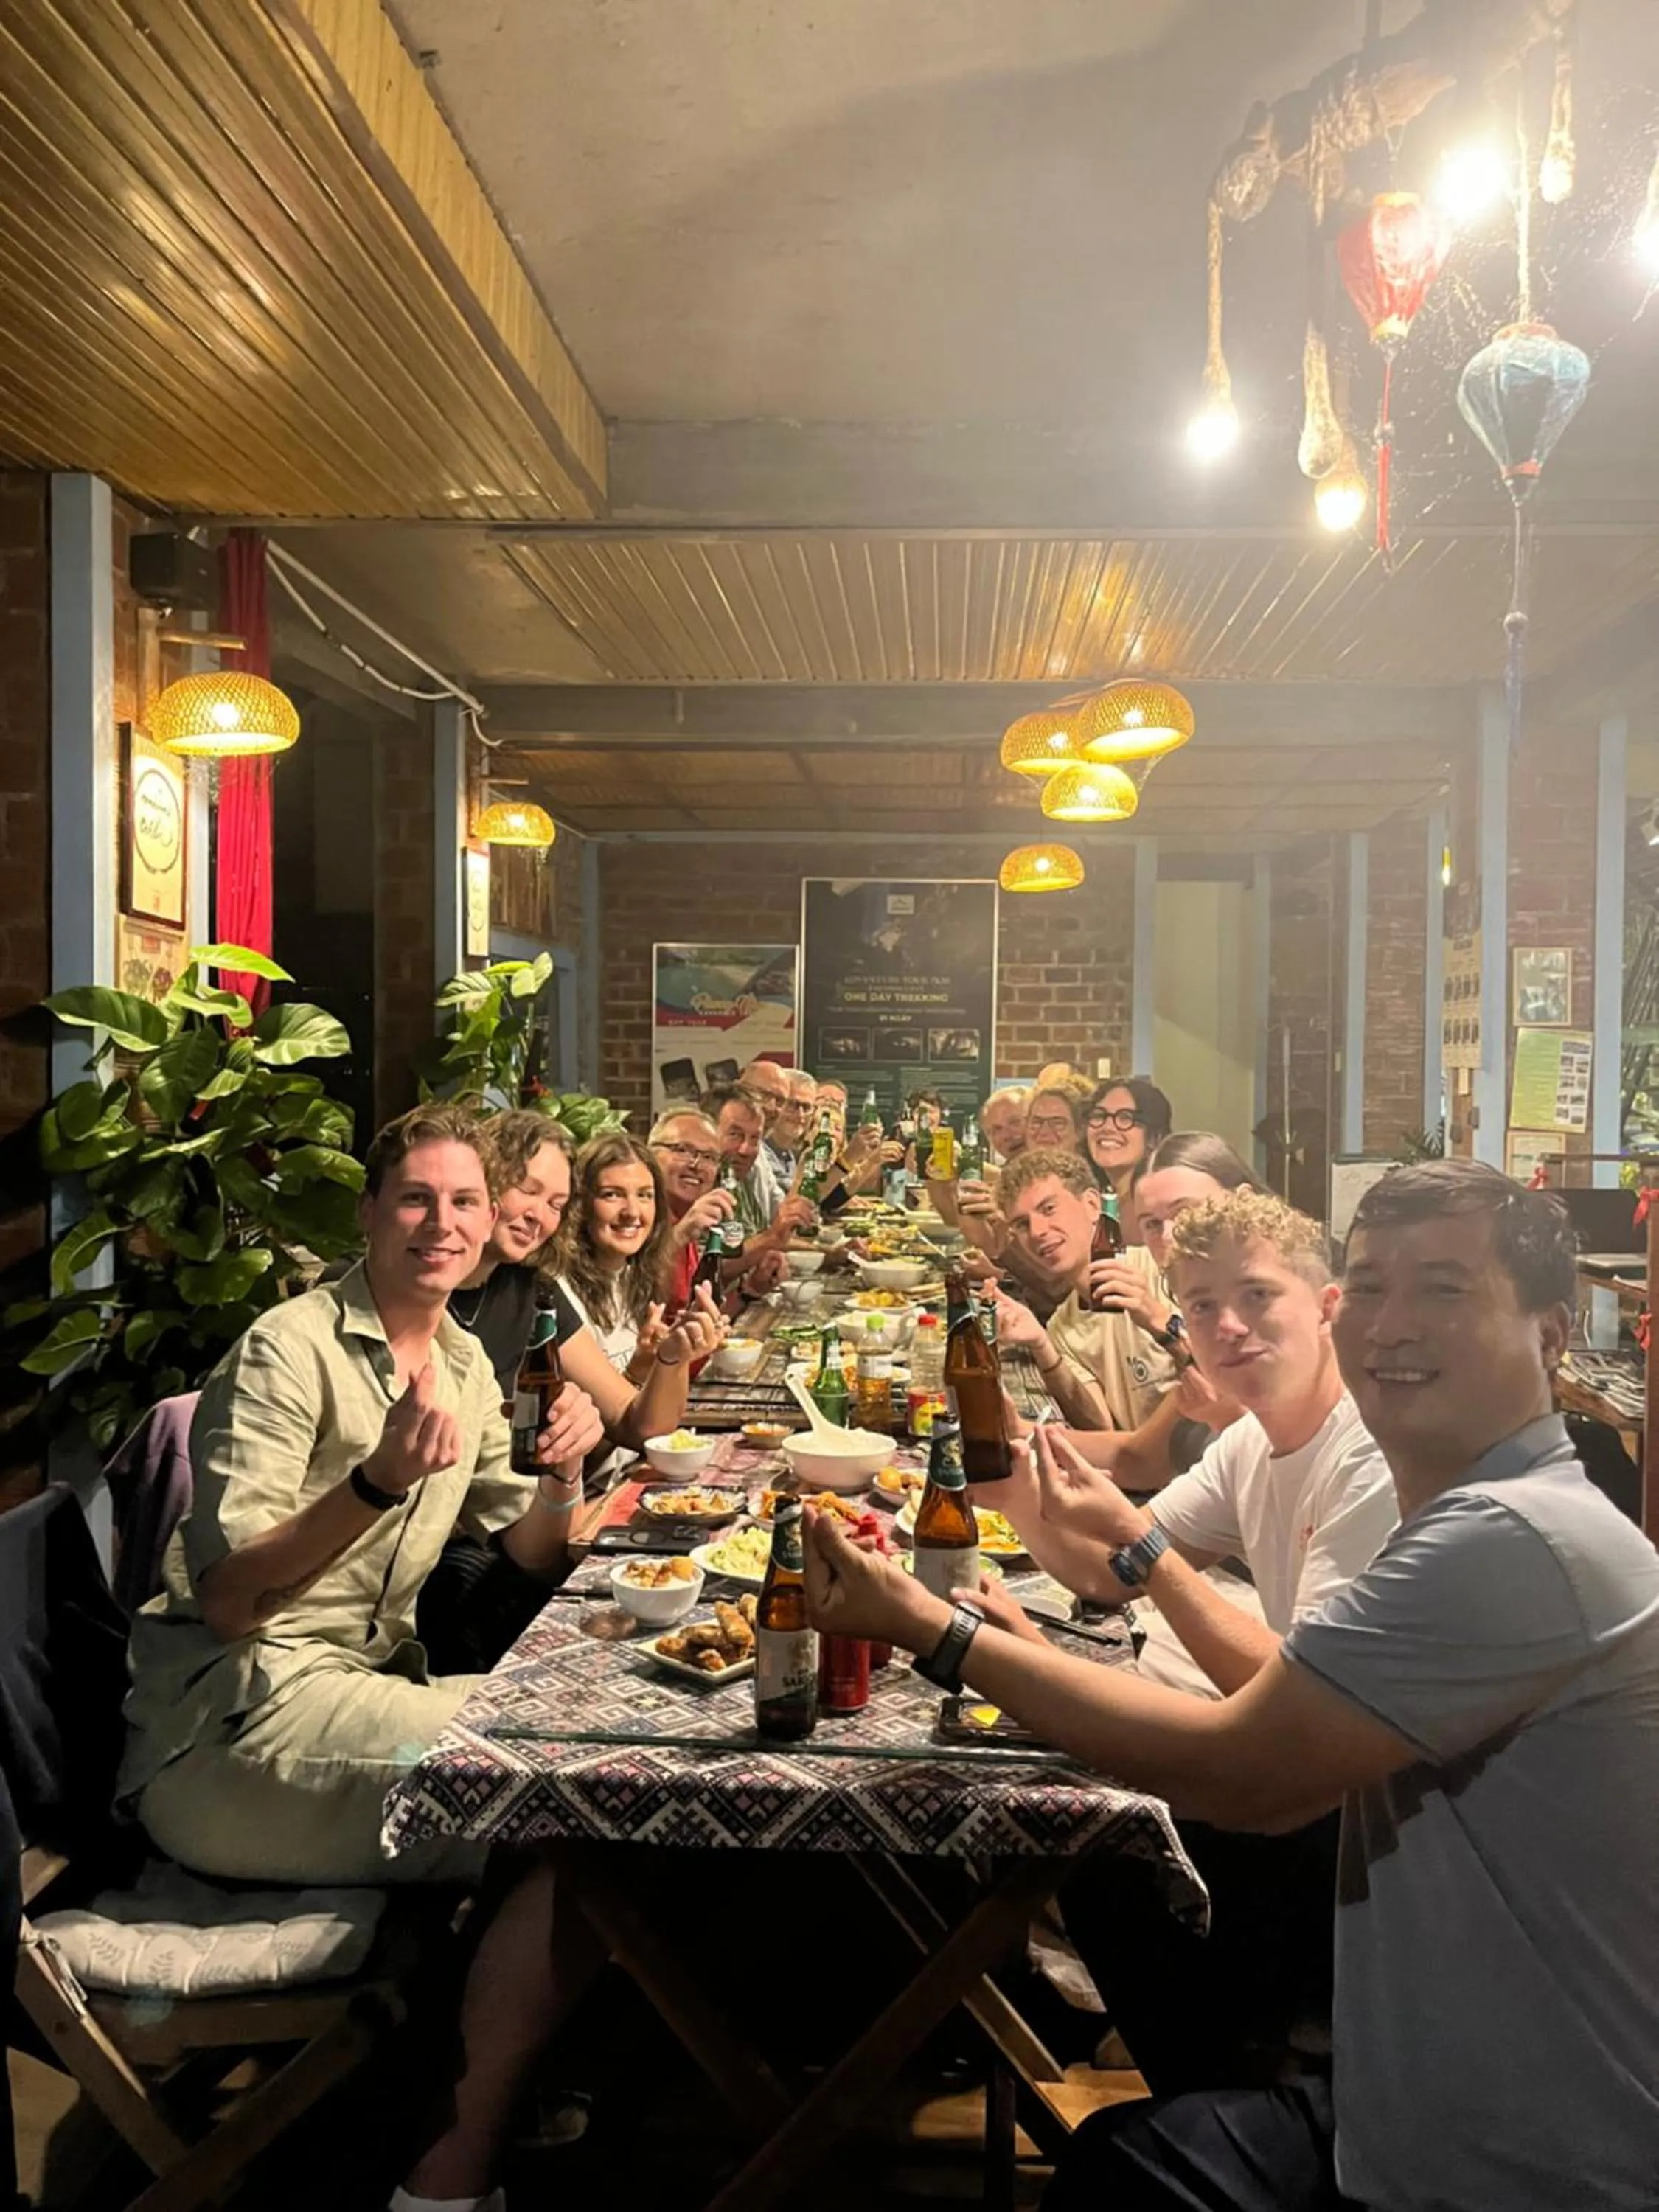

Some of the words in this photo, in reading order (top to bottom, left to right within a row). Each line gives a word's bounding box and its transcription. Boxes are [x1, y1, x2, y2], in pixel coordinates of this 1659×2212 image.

[844, 992, 867, 1001] ONE
[870, 992, 892, 1001] DAY
[894, 993, 949, 1003] TREKKING
